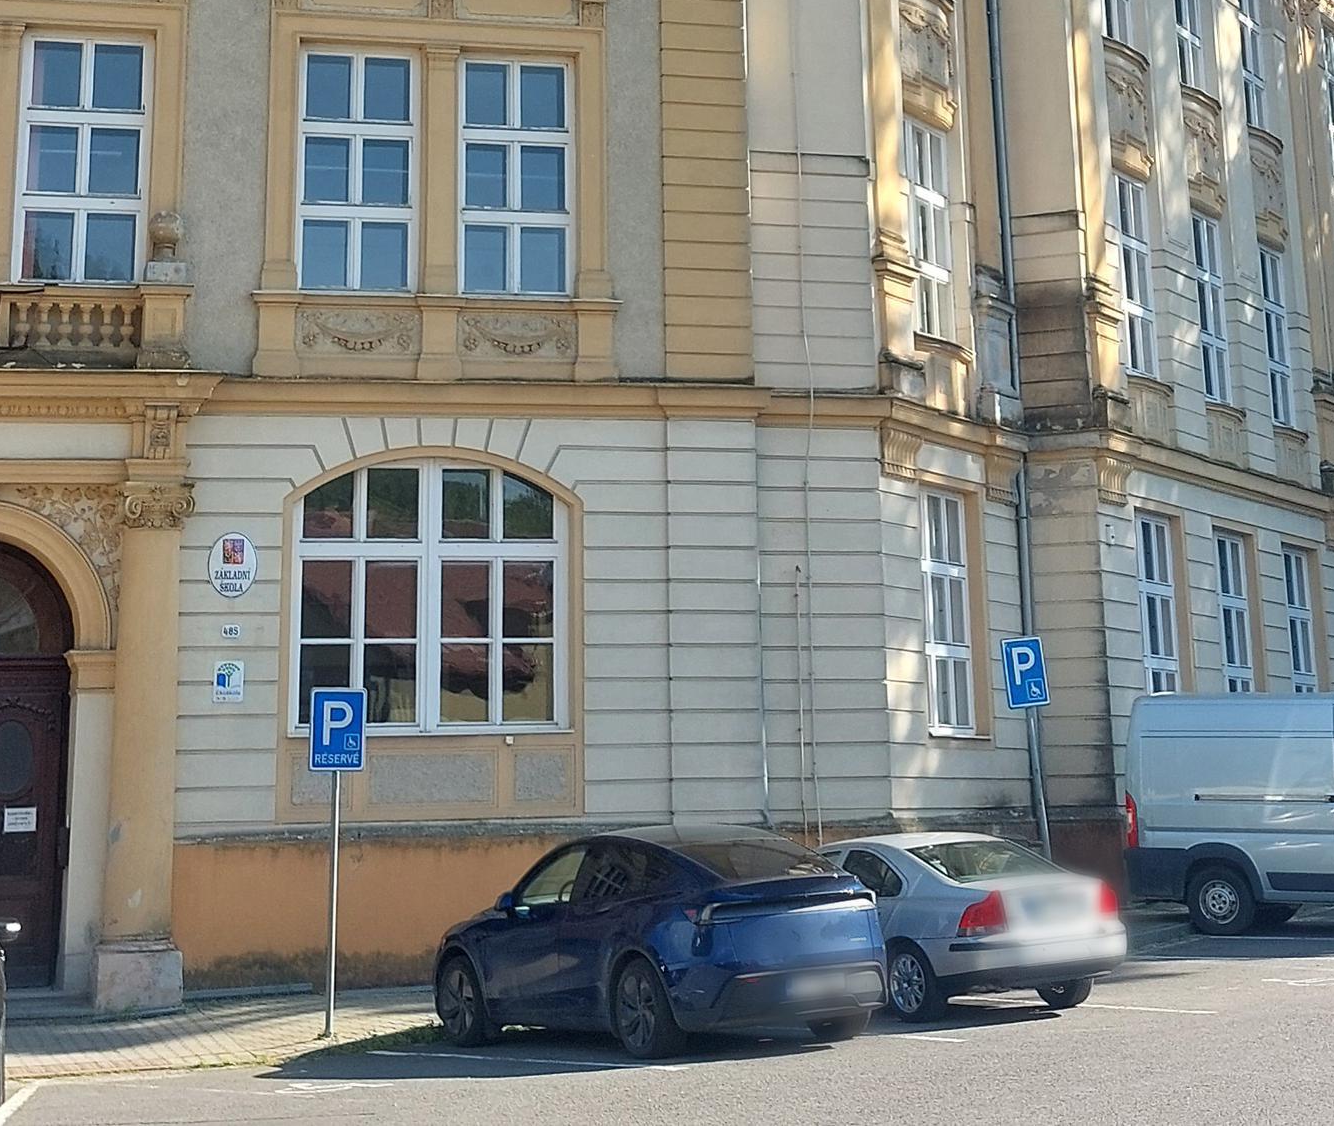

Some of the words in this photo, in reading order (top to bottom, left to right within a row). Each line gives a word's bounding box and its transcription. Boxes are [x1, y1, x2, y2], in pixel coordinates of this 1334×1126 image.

[214, 567, 251, 580] ZÁKLADNÍ
[219, 581, 244, 592] ŠKOLA
[1011, 646, 1035, 685] P
[323, 701, 353, 746] P
